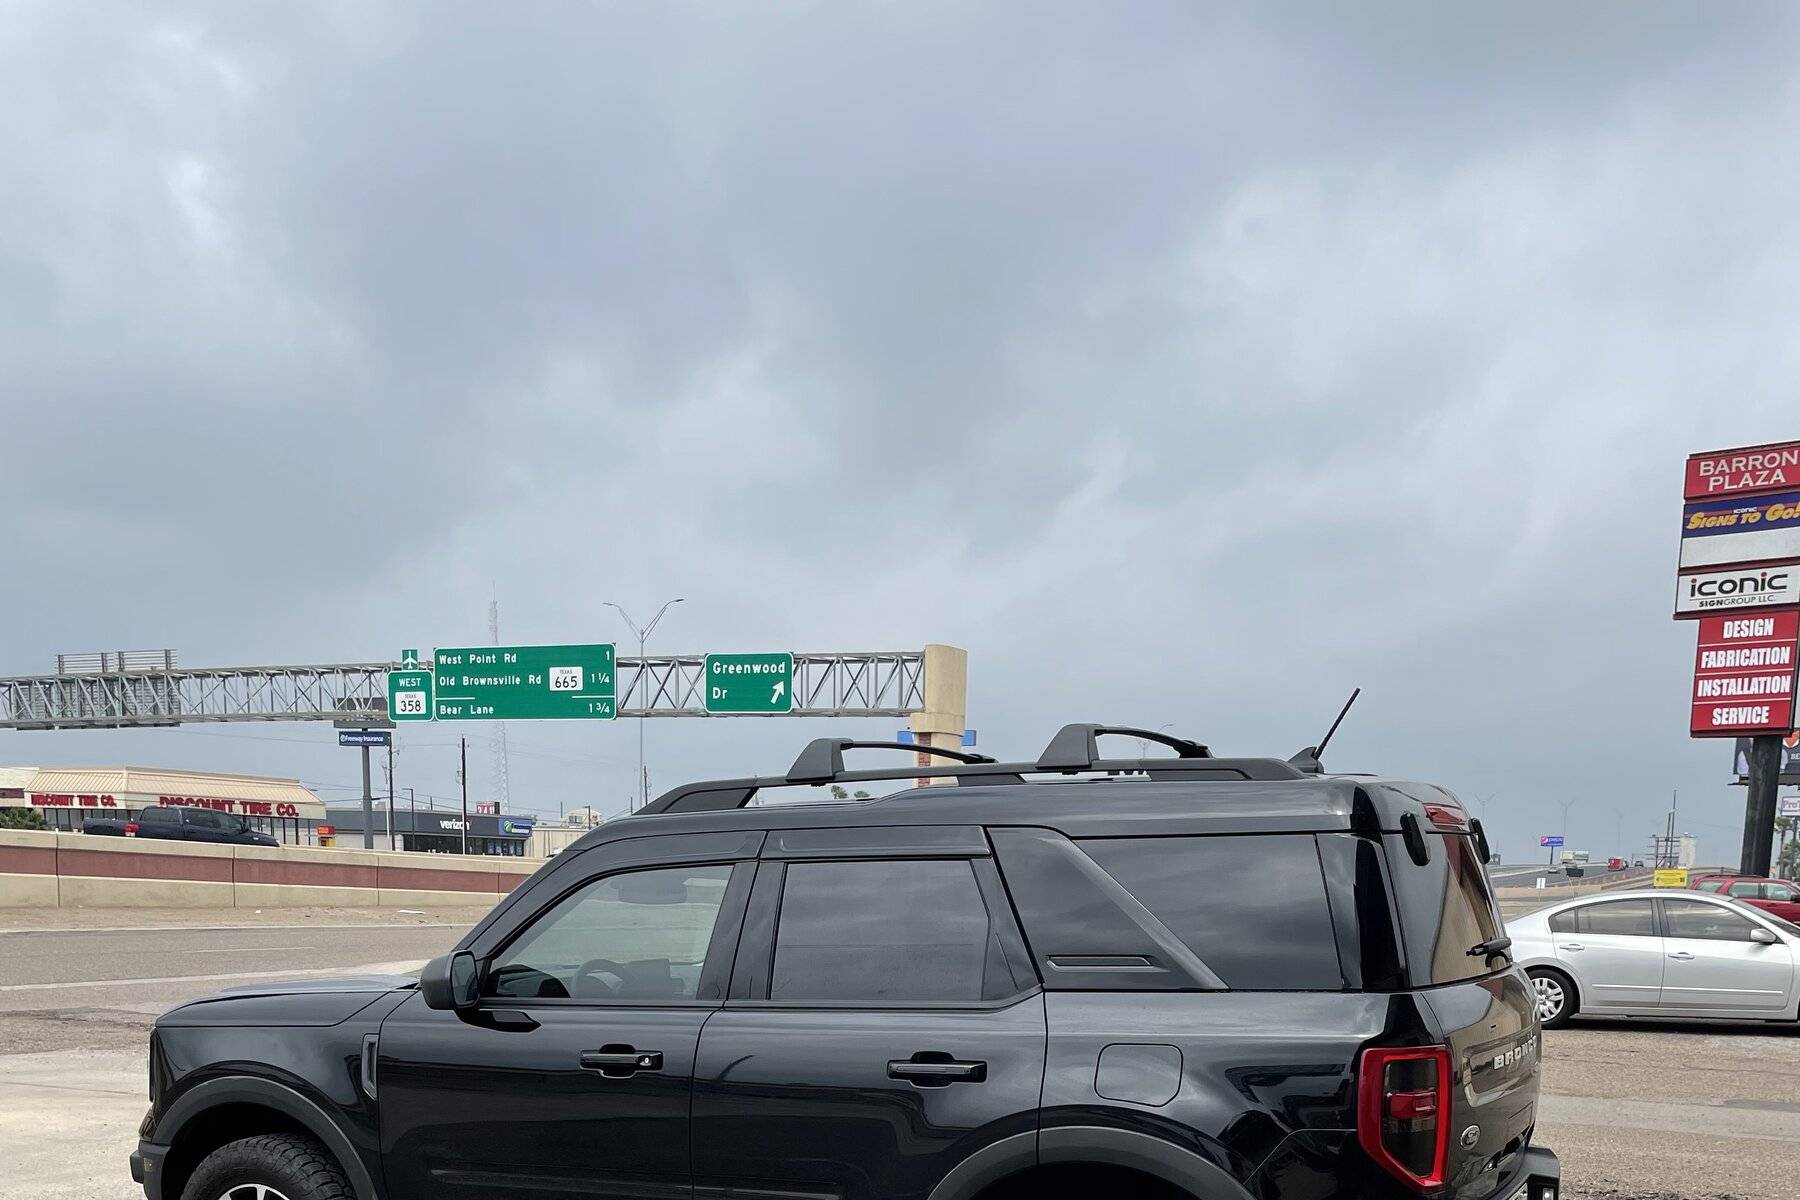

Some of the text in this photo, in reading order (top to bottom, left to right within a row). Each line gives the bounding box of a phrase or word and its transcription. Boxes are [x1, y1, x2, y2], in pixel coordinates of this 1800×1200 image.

[1699, 449, 1798, 476] BARRON
[1708, 468, 1786, 491] PLAZA
[1690, 571, 1788, 598] iconic
[1722, 618, 1774, 639] DESIGN
[439, 650, 610, 665] West Point Rd 1
[1700, 646, 1790, 669] FABRICATION
[712, 661, 786, 675] Greenwood
[399, 678, 421, 687] WEST
[440, 674, 542, 686] Old Brownsville Rd
[555, 676, 578, 688] 665
[1697, 675, 1791, 697] INSTALLATION
[712, 687, 728, 699] Dr
[400, 700, 421, 712] 358
[440, 704, 462, 715] Bear
[470, 704, 494, 714] Lane
[1712, 706, 1770, 725] SERVICE
[239, 801, 272, 815] TIRE
[276, 802, 299, 817] CO.
